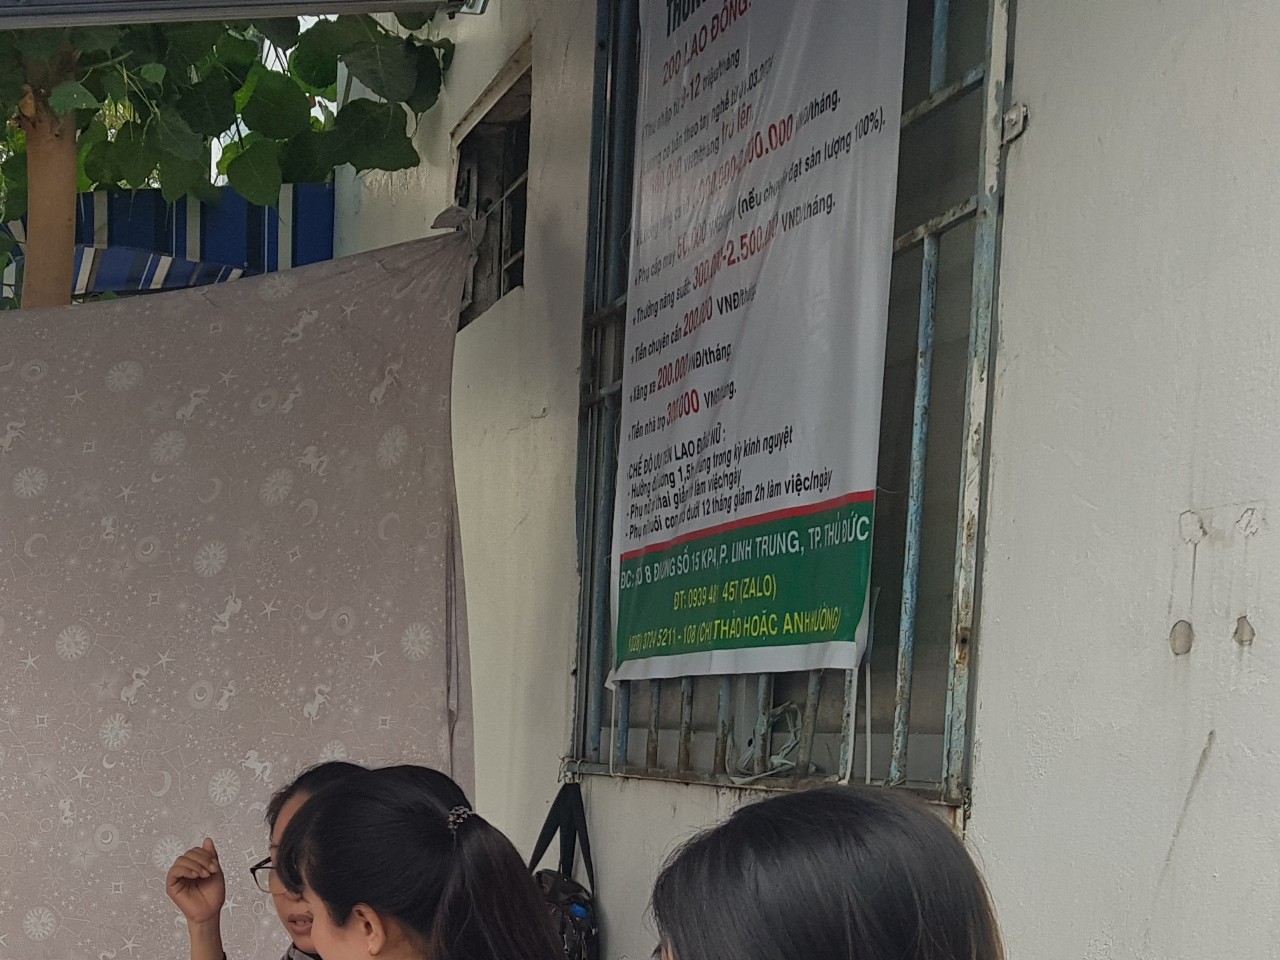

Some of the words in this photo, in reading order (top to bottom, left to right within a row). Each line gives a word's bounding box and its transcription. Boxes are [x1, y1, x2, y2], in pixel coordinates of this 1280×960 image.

[662, 49, 681, 87] 200
[683, 24, 708, 67] LAO
[737, 187, 762, 219] (nếu
[804, 146, 821, 173] sản
[824, 132, 852, 159] lượng
[674, 440, 696, 461] LAO
[713, 449, 732, 468] trong
[743, 436, 761, 457] kinh
[763, 425, 793, 454] nguyệt
[702, 499, 710, 516] 12
[734, 485, 752, 512] giảm
[755, 483, 765, 502] 2h
[767, 479, 781, 499] làm
[784, 466, 832, 496] việc/ngày
[677, 545, 690, 574] SỐ
[691, 551, 700, 571] 15
[732, 539, 752, 562] LINH
[755, 530, 805, 557] TRUNG,
[688, 586, 707, 608] 0939
[722, 580, 739, 602] 457
[740, 573, 777, 605] (ZALO)
[743, 608, 778, 640] HOẶC
